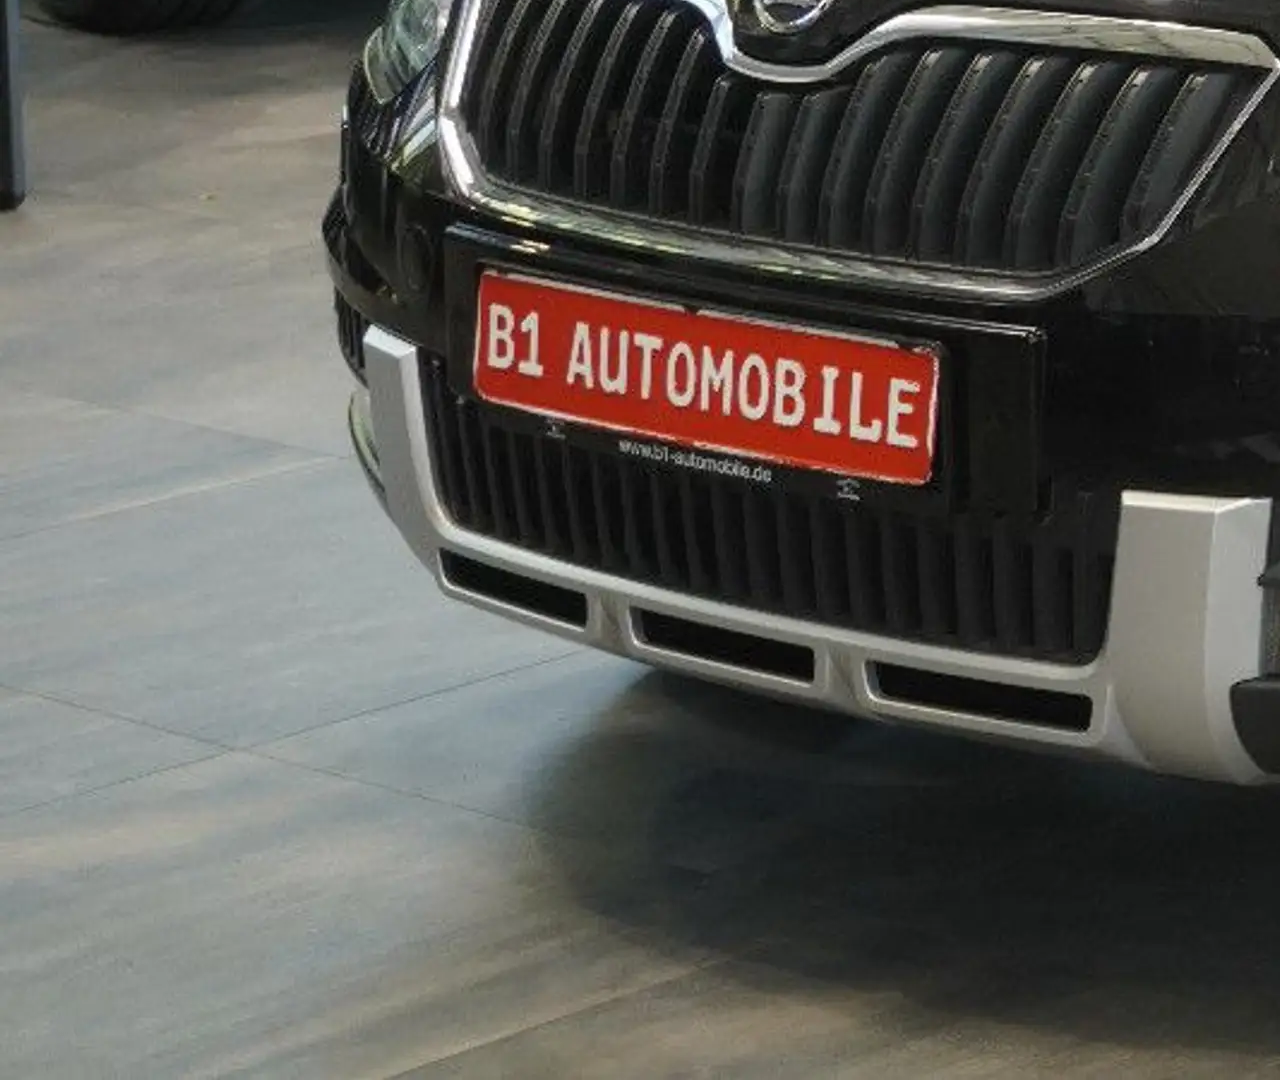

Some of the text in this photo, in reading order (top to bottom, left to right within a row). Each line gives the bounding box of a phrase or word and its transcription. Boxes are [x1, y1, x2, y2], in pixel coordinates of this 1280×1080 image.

[487, 303, 921, 449] B1 AUTOMOBILE
[618, 439, 772, 483] www.b1-automobile.de
